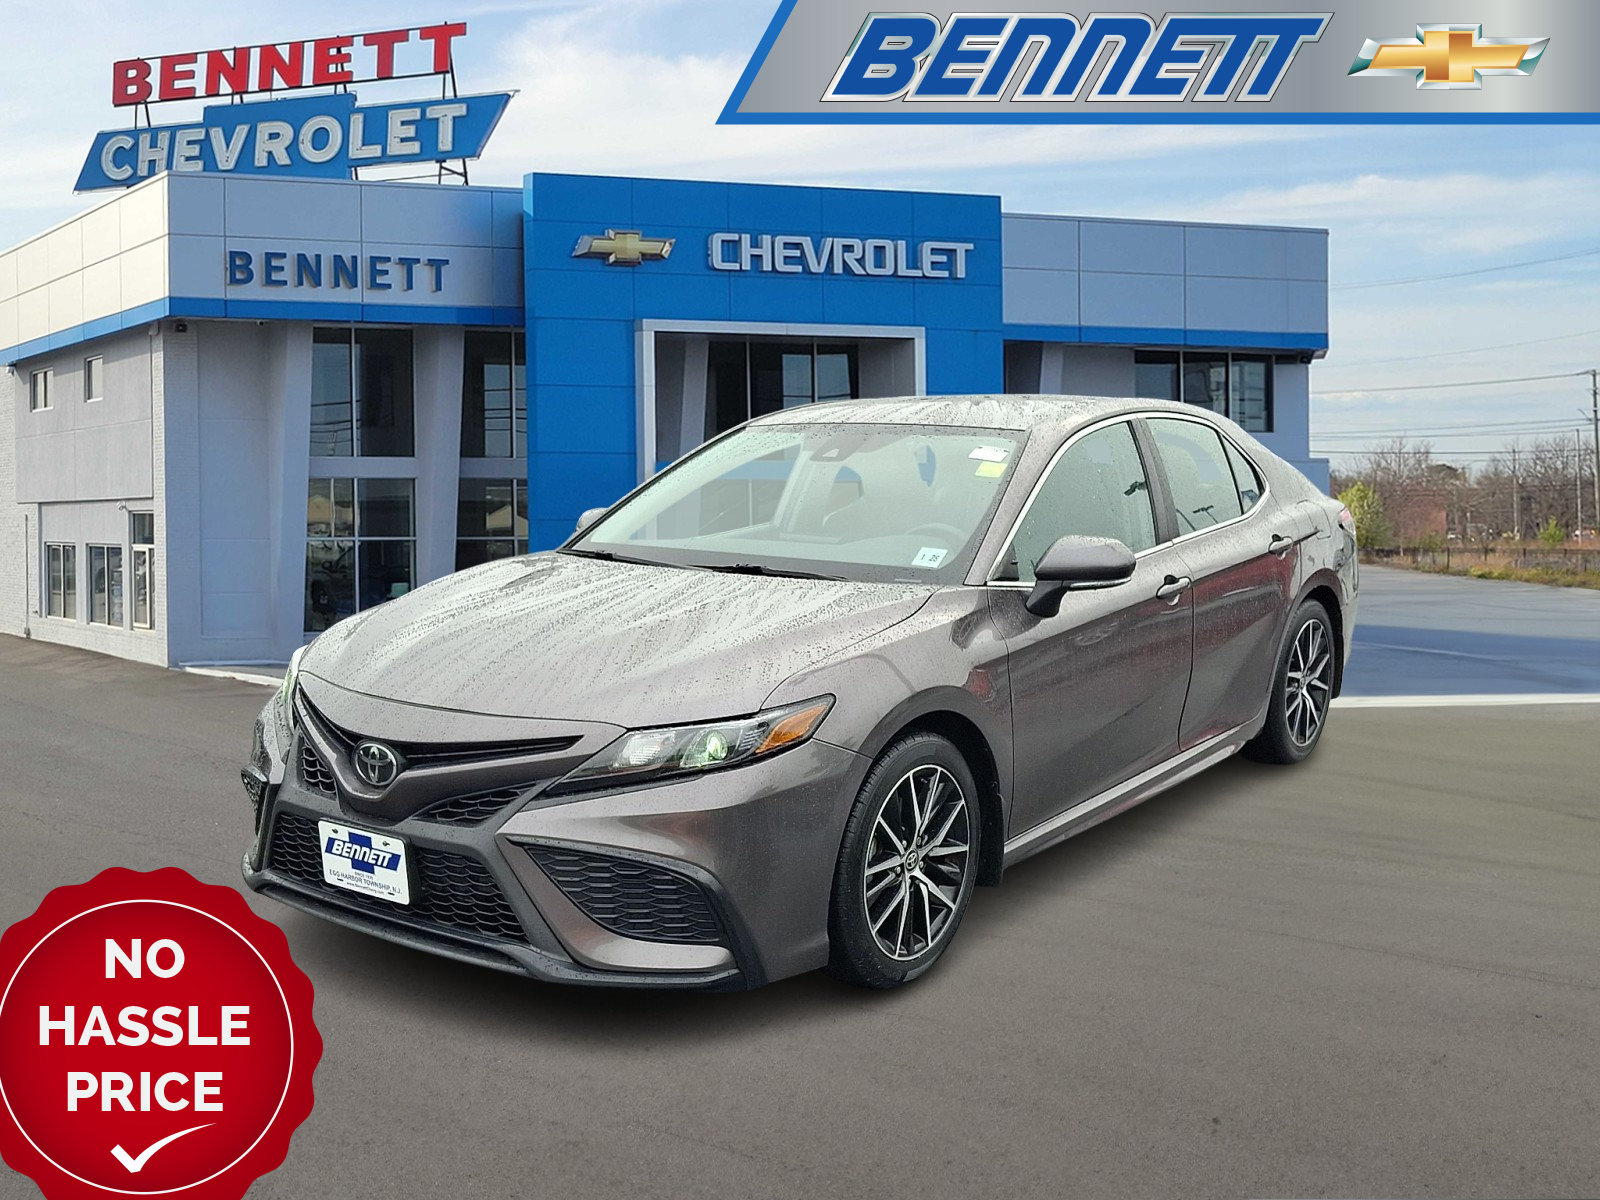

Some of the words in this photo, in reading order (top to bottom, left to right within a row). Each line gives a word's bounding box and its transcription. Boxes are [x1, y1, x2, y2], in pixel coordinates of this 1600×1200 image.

[112, 22, 467, 106] BENNETT
[100, 102, 469, 181] CHEVROLET
[226, 250, 449, 293] BENNETT
[708, 232, 975, 279] CHEVROLET
[329, 868, 340, 878] EGG
[341, 872, 362, 884] HARBOR
[331, 840, 393, 868] BENNETT
